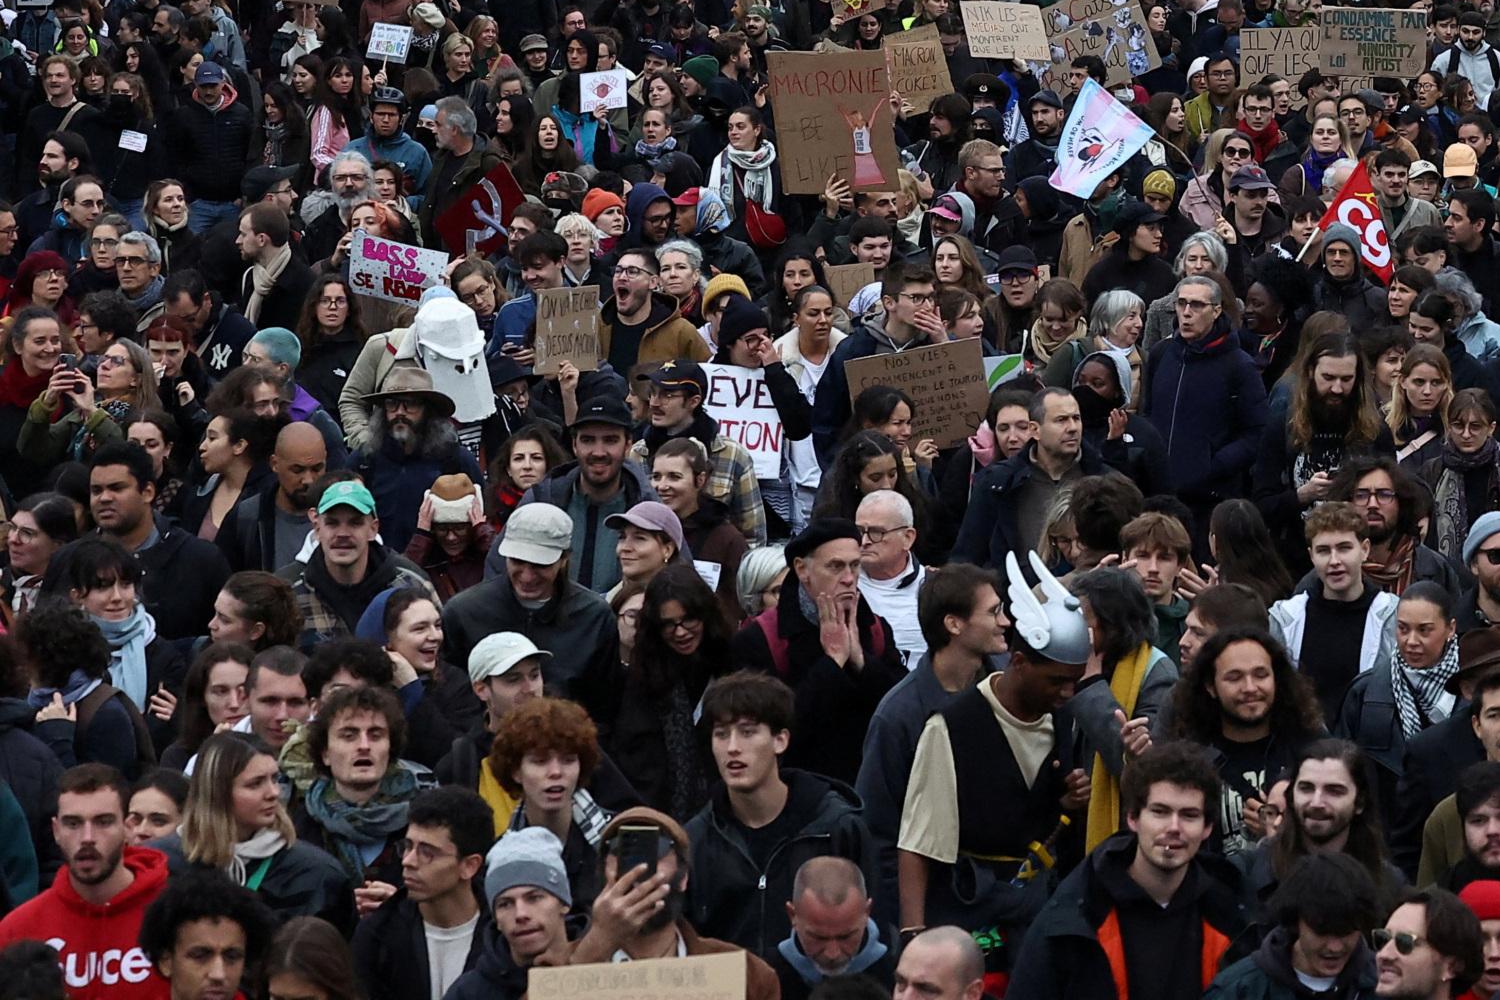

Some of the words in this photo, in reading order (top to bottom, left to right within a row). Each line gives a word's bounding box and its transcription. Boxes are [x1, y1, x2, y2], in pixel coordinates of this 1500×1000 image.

[965, 7, 993, 22] NIK
[999, 6, 1018, 22] LES
[1400, 12, 1427, 31] PAR
[1065, 35, 1099, 62] Are
[1242, 31, 1264, 51] IL
[1245, 55, 1275, 76] QUE
[1286, 53, 1311, 76] LES
[772, 66, 887, 99] MACRONIE
[801, 114, 824, 141] BE
[362, 237, 419, 270] BOSS
[353, 271, 376, 290] SE
[389, 264, 427, 285] LADY
